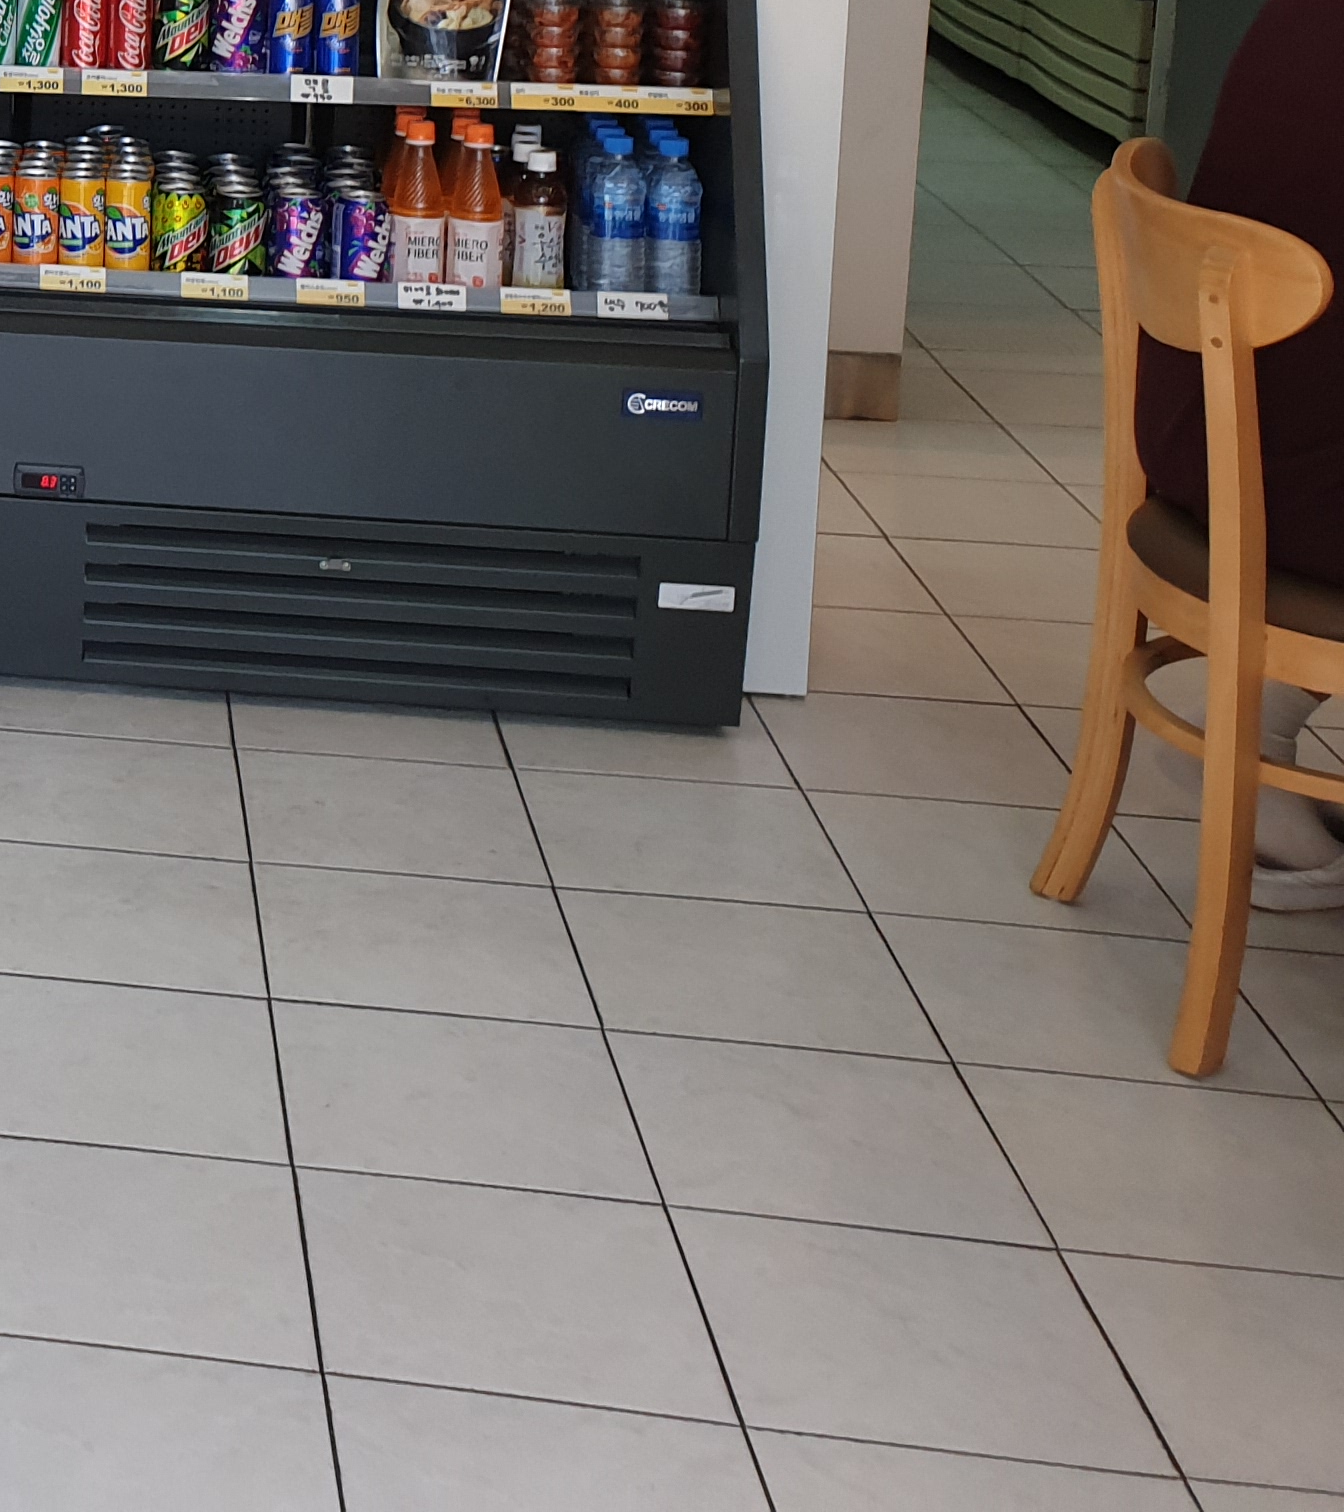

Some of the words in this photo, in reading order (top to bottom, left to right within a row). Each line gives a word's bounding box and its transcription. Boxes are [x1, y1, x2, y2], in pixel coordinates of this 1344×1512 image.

[19, 81, 59, 90] ₩1,300
[102, 84, 142, 93] ₩1,300
[544, 97, 575, 107] ₩300
[608, 100, 639, 110] ₩400
[676, 101, 708, 112] ₩300
[60, 279, 101, 290] ₩1,100
[202, 287, 244, 298] ₩1,100
[521, 303, 565, 313] ₩1,200
[645, 399, 698, 412] CRECOM
